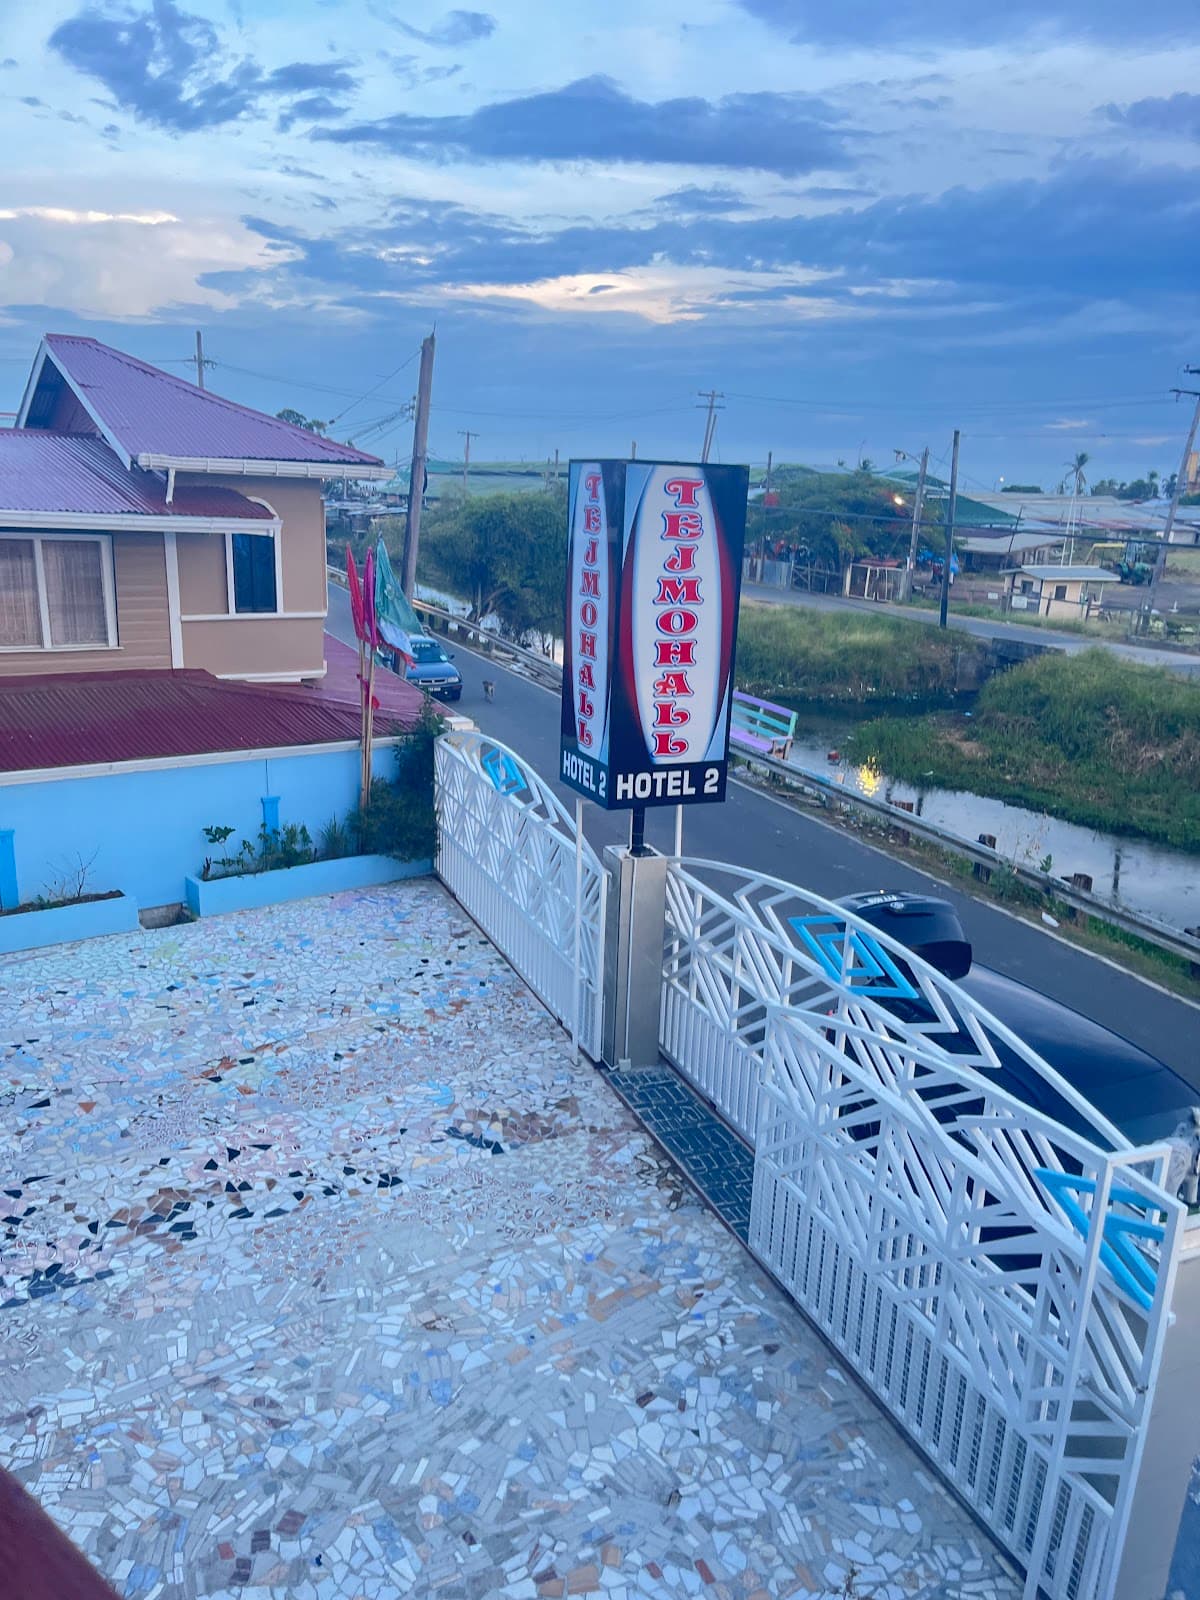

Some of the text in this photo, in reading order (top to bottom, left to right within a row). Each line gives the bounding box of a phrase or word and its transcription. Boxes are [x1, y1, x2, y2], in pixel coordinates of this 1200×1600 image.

[578, 473, 601, 748] TEJMOHALL
[652, 478, 704, 756] TEJMOHALL
[563, 750, 607, 798] HOTEL 2
[616, 767, 720, 800] HOTEL 2
